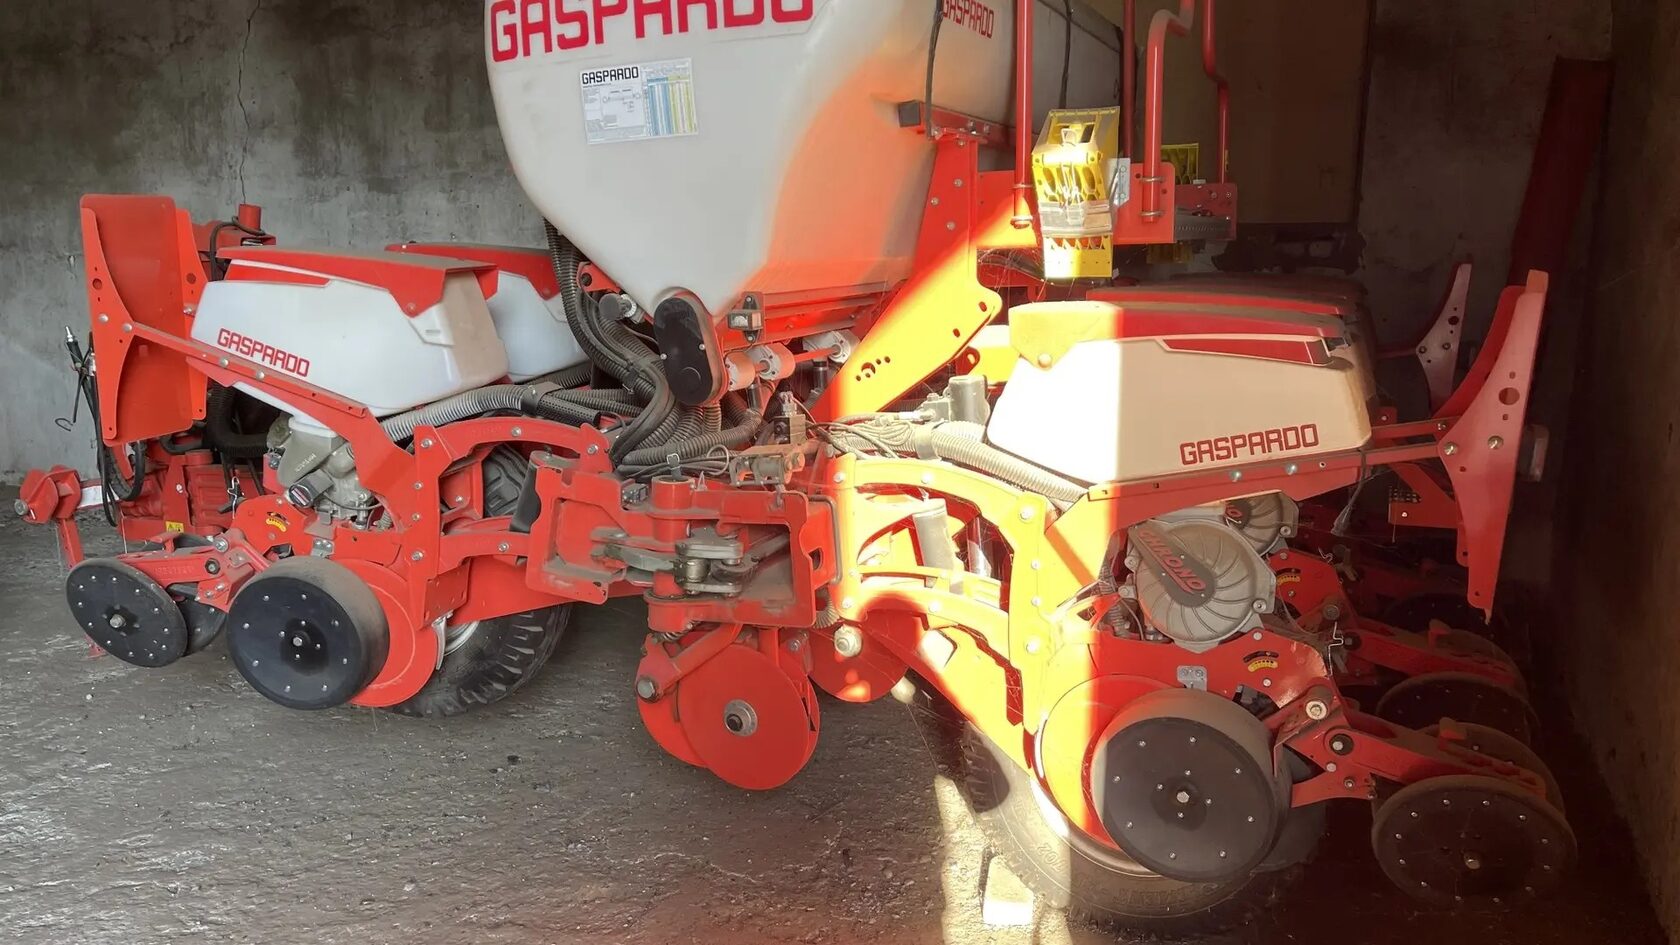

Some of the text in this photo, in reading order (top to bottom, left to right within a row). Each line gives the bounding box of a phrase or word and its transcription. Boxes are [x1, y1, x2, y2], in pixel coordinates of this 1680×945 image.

[581, 66, 639, 85] GASPARDO
[217, 328, 310, 377] GASPARDO
[1179, 423, 1320, 466] GASPARDO
[1139, 528, 1206, 591] CHRONO
